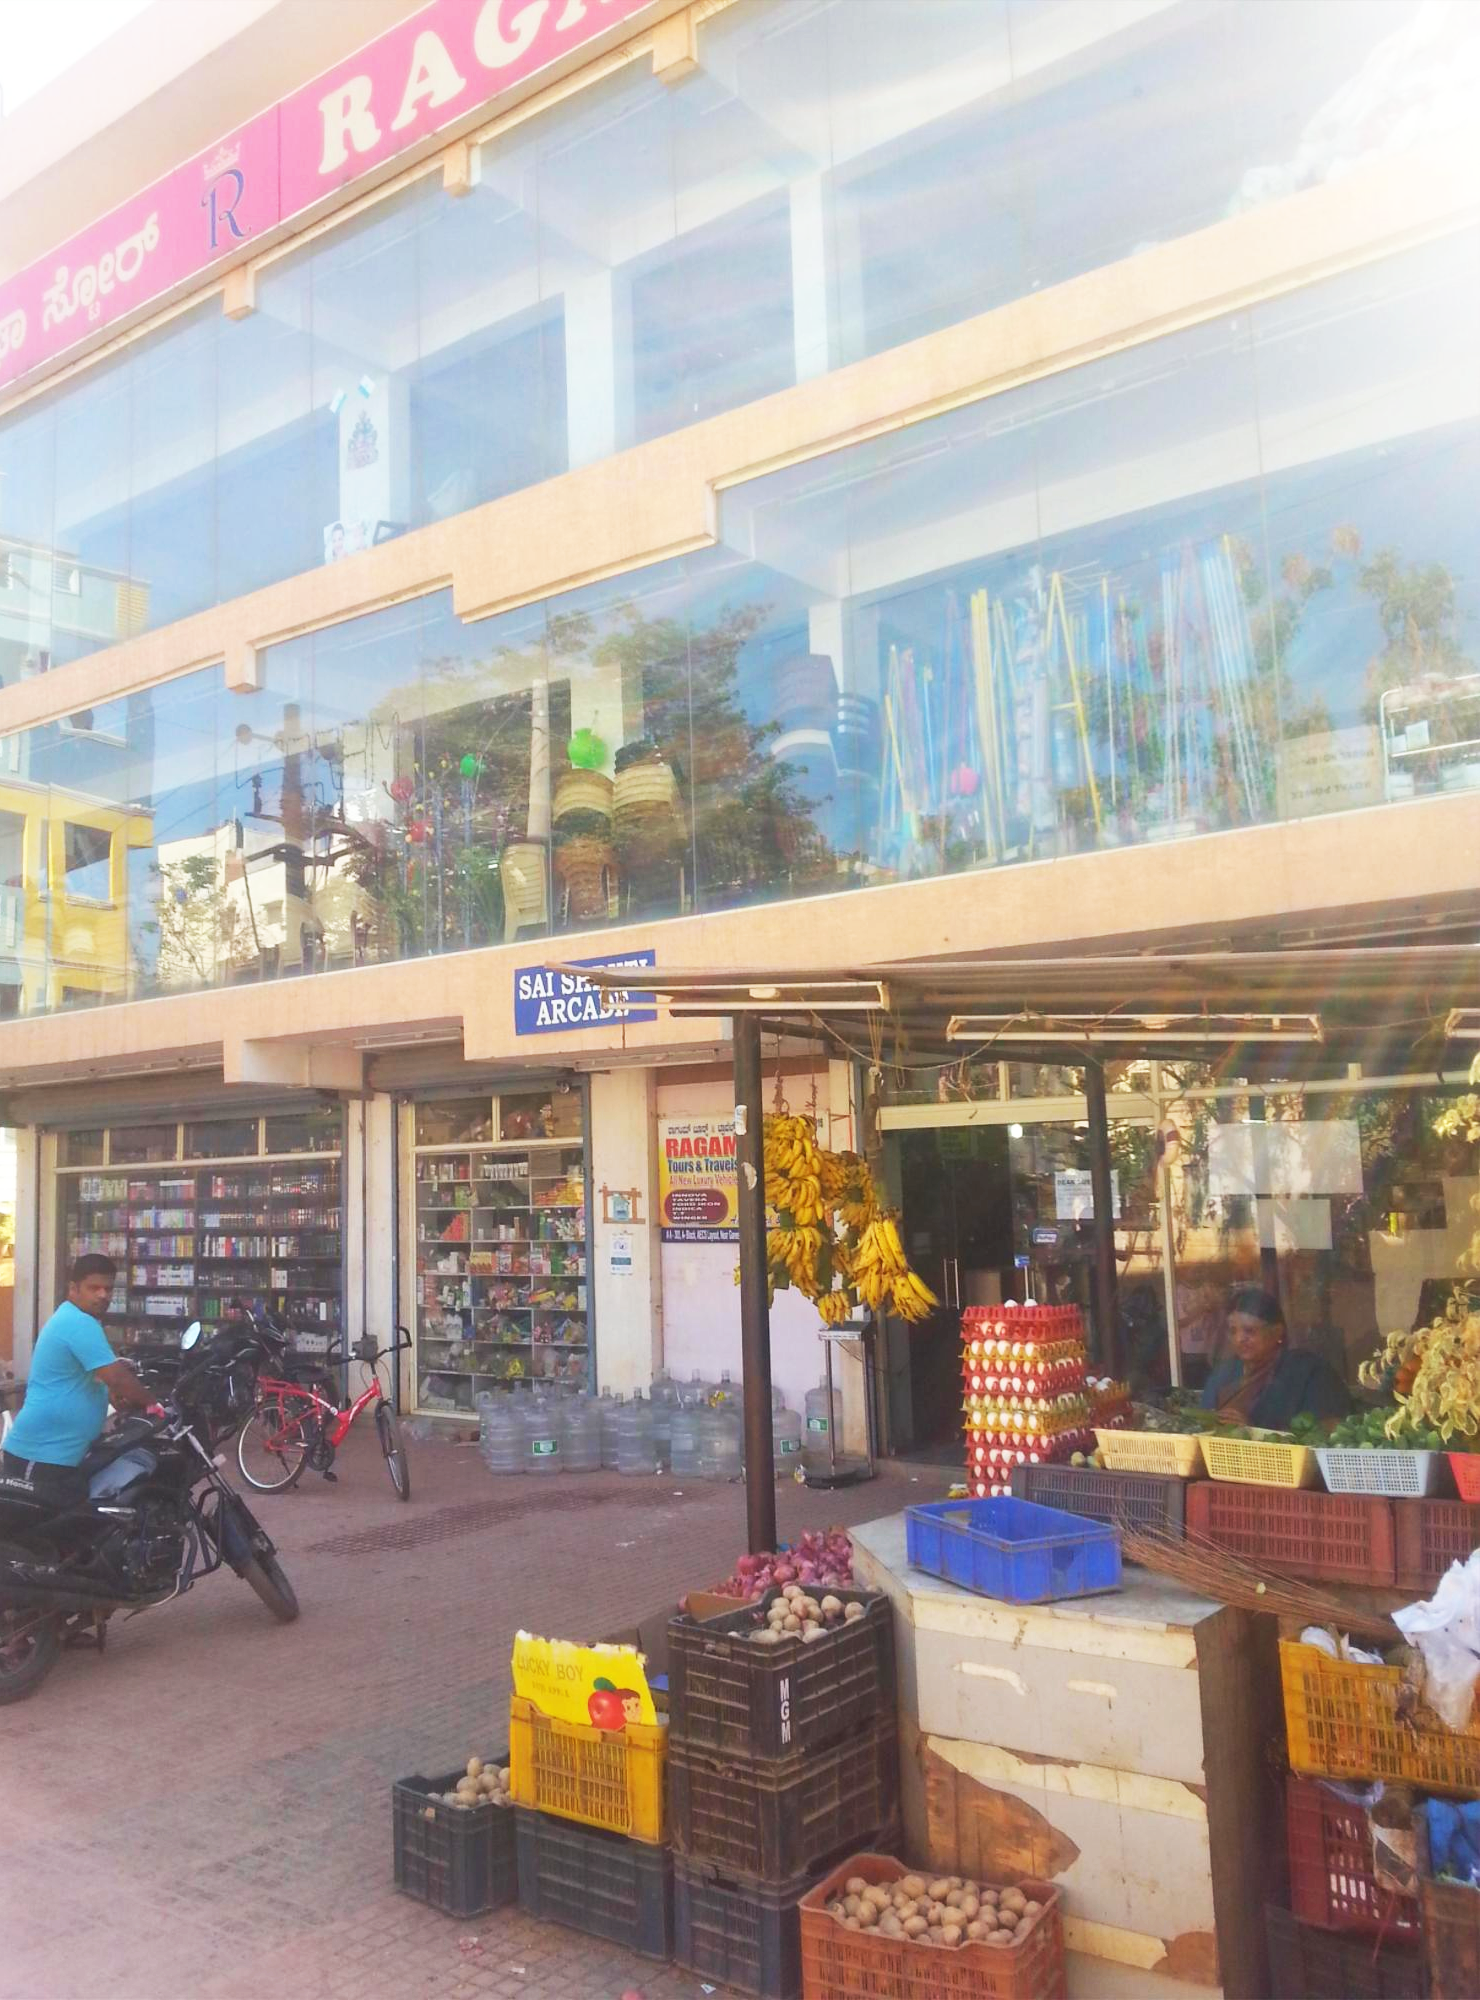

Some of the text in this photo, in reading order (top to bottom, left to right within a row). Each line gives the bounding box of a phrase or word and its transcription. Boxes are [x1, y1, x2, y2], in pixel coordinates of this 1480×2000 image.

[519, 972, 554, 1000] SAI
[667, 1158, 694, 1173] Tours
[696, 1160, 702, 1172] &
[517, 1654, 584, 1682] LUCKY BOY
[780, 1677, 791, 1745] MGM
